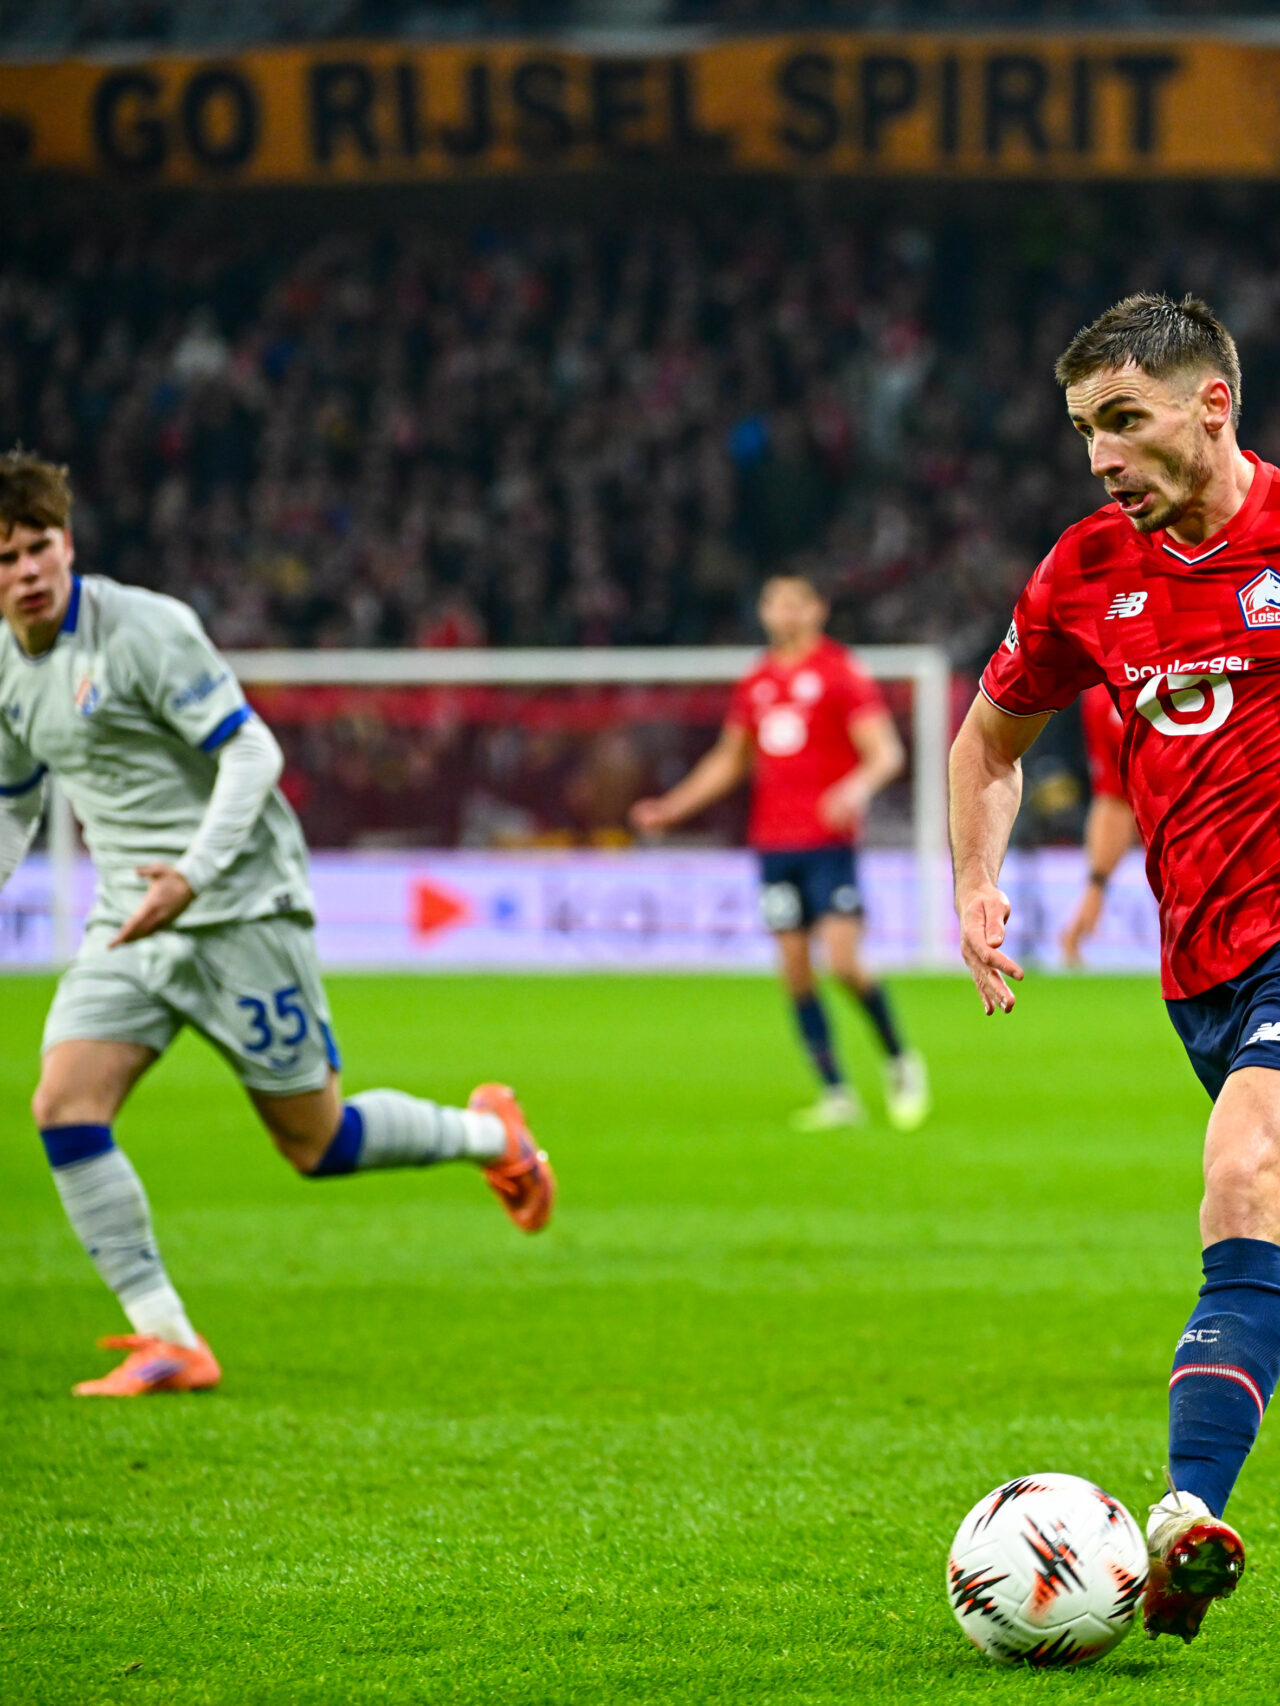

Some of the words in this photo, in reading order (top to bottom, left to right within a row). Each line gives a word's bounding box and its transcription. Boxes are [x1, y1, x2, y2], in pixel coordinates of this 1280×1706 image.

[92, 68, 262, 176] GO
[308, 56, 732, 168] RIJSEL
[776, 50, 1182, 158] SPIRIT
[236, 986, 309, 1053] 35
